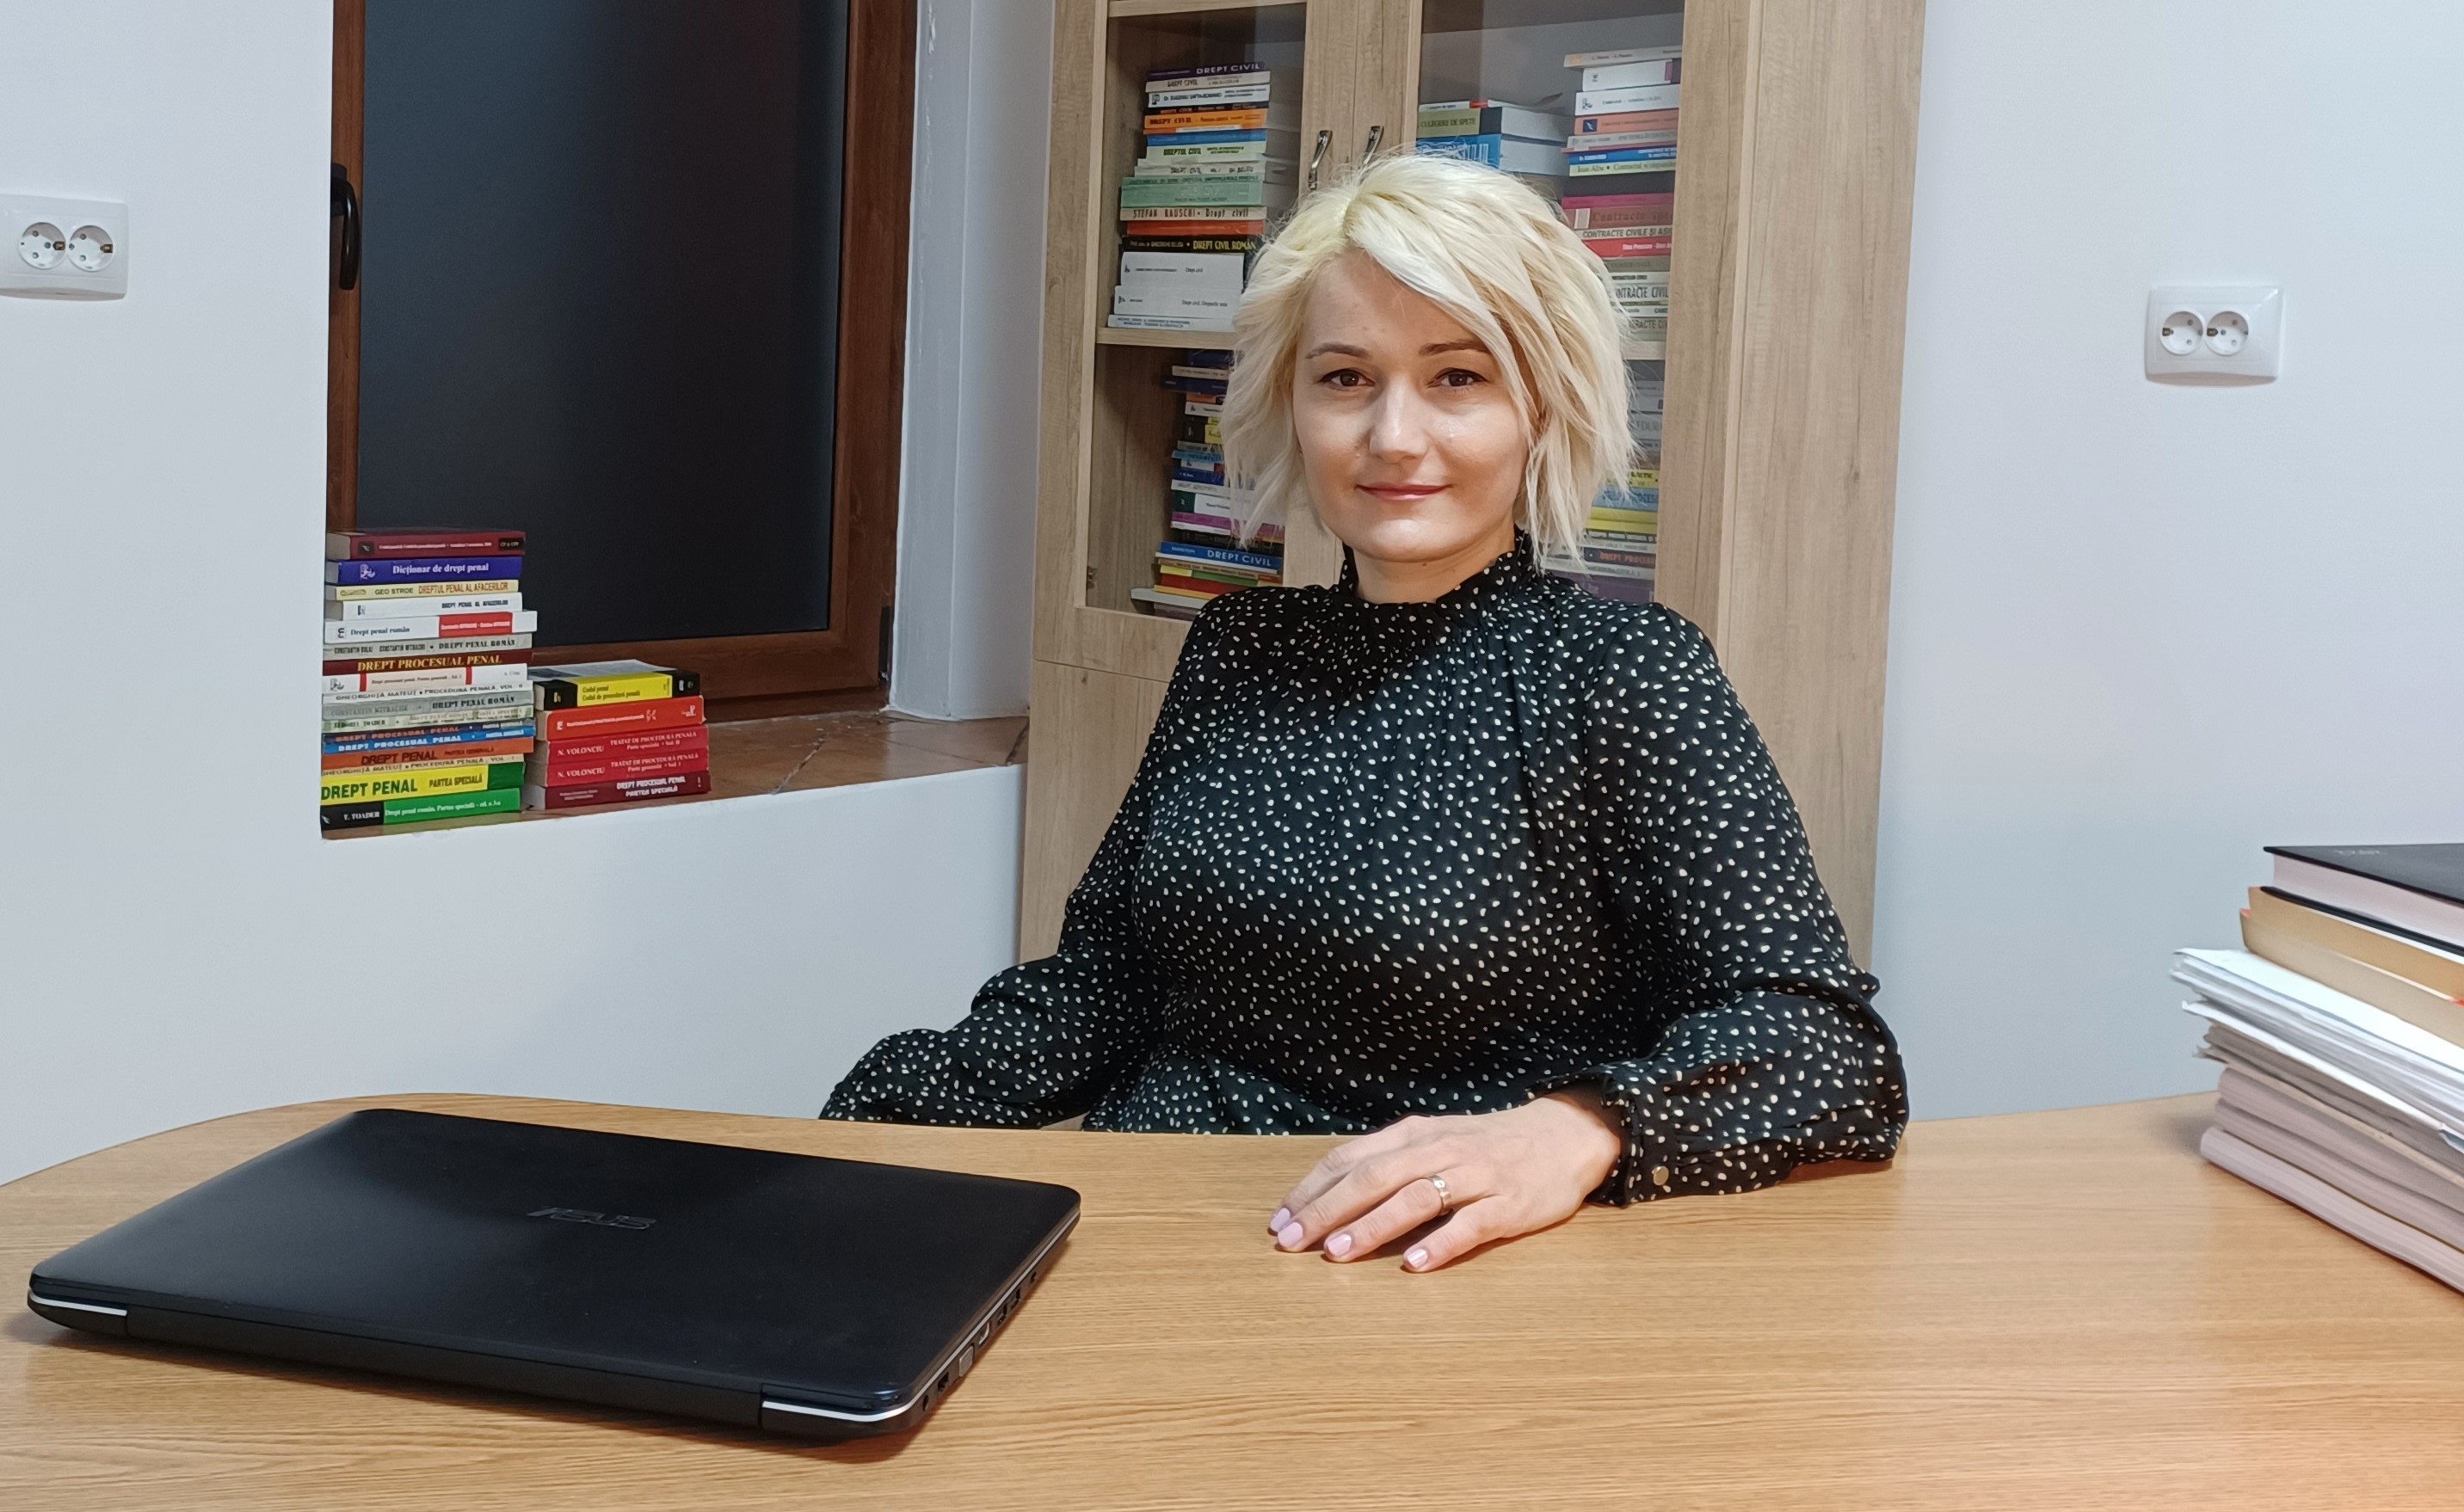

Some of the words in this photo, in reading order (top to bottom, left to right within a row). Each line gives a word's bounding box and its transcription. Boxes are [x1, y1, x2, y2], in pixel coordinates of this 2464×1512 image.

[1205, 209, 1225, 218] Drept
[1232, 208, 1248, 217] civil
[1582, 230, 1623, 238] CONTRACTE
[1207, 550, 1240, 561] DREPT
[1241, 556, 1272, 567] CIVIL
[433, 564, 442, 573] de
[444, 563, 465, 574] drept
[467, 563, 490, 574] penal
[418, 584, 445, 594] DREPTUL
[446, 584, 465, 593] PENAL
[473, 582, 508, 592] AFACERILOR
[350, 629, 369, 637] Drept
[370, 627, 388, 636] penal
[465, 640, 490, 648] PENAL
[357, 659, 397, 672] DREPT
[397, 657, 465, 669] PROCESUAL
[466, 655, 502, 665] PENAL
[432, 700, 459, 710] DREPT
[460, 698, 486, 707] PENAL
[338, 742, 368, 752] DREPT
[374, 738, 428, 748] PROCESUAL
[566, 746, 605, 756] VOLONCIU
[360, 753, 397, 765] DREPT
[401, 750, 438, 761] PENAL
[566, 767, 606, 778] VOLONCIU
[321, 783, 368, 800] DREPT
[372, 778, 418, 795] PENAL
[428, 778, 453, 788] PARTEA
[454, 774, 483, 786] SPECIALĂ
[352, 811, 380, 820] TOADER
[527, 1207, 656, 1230] ASUS
